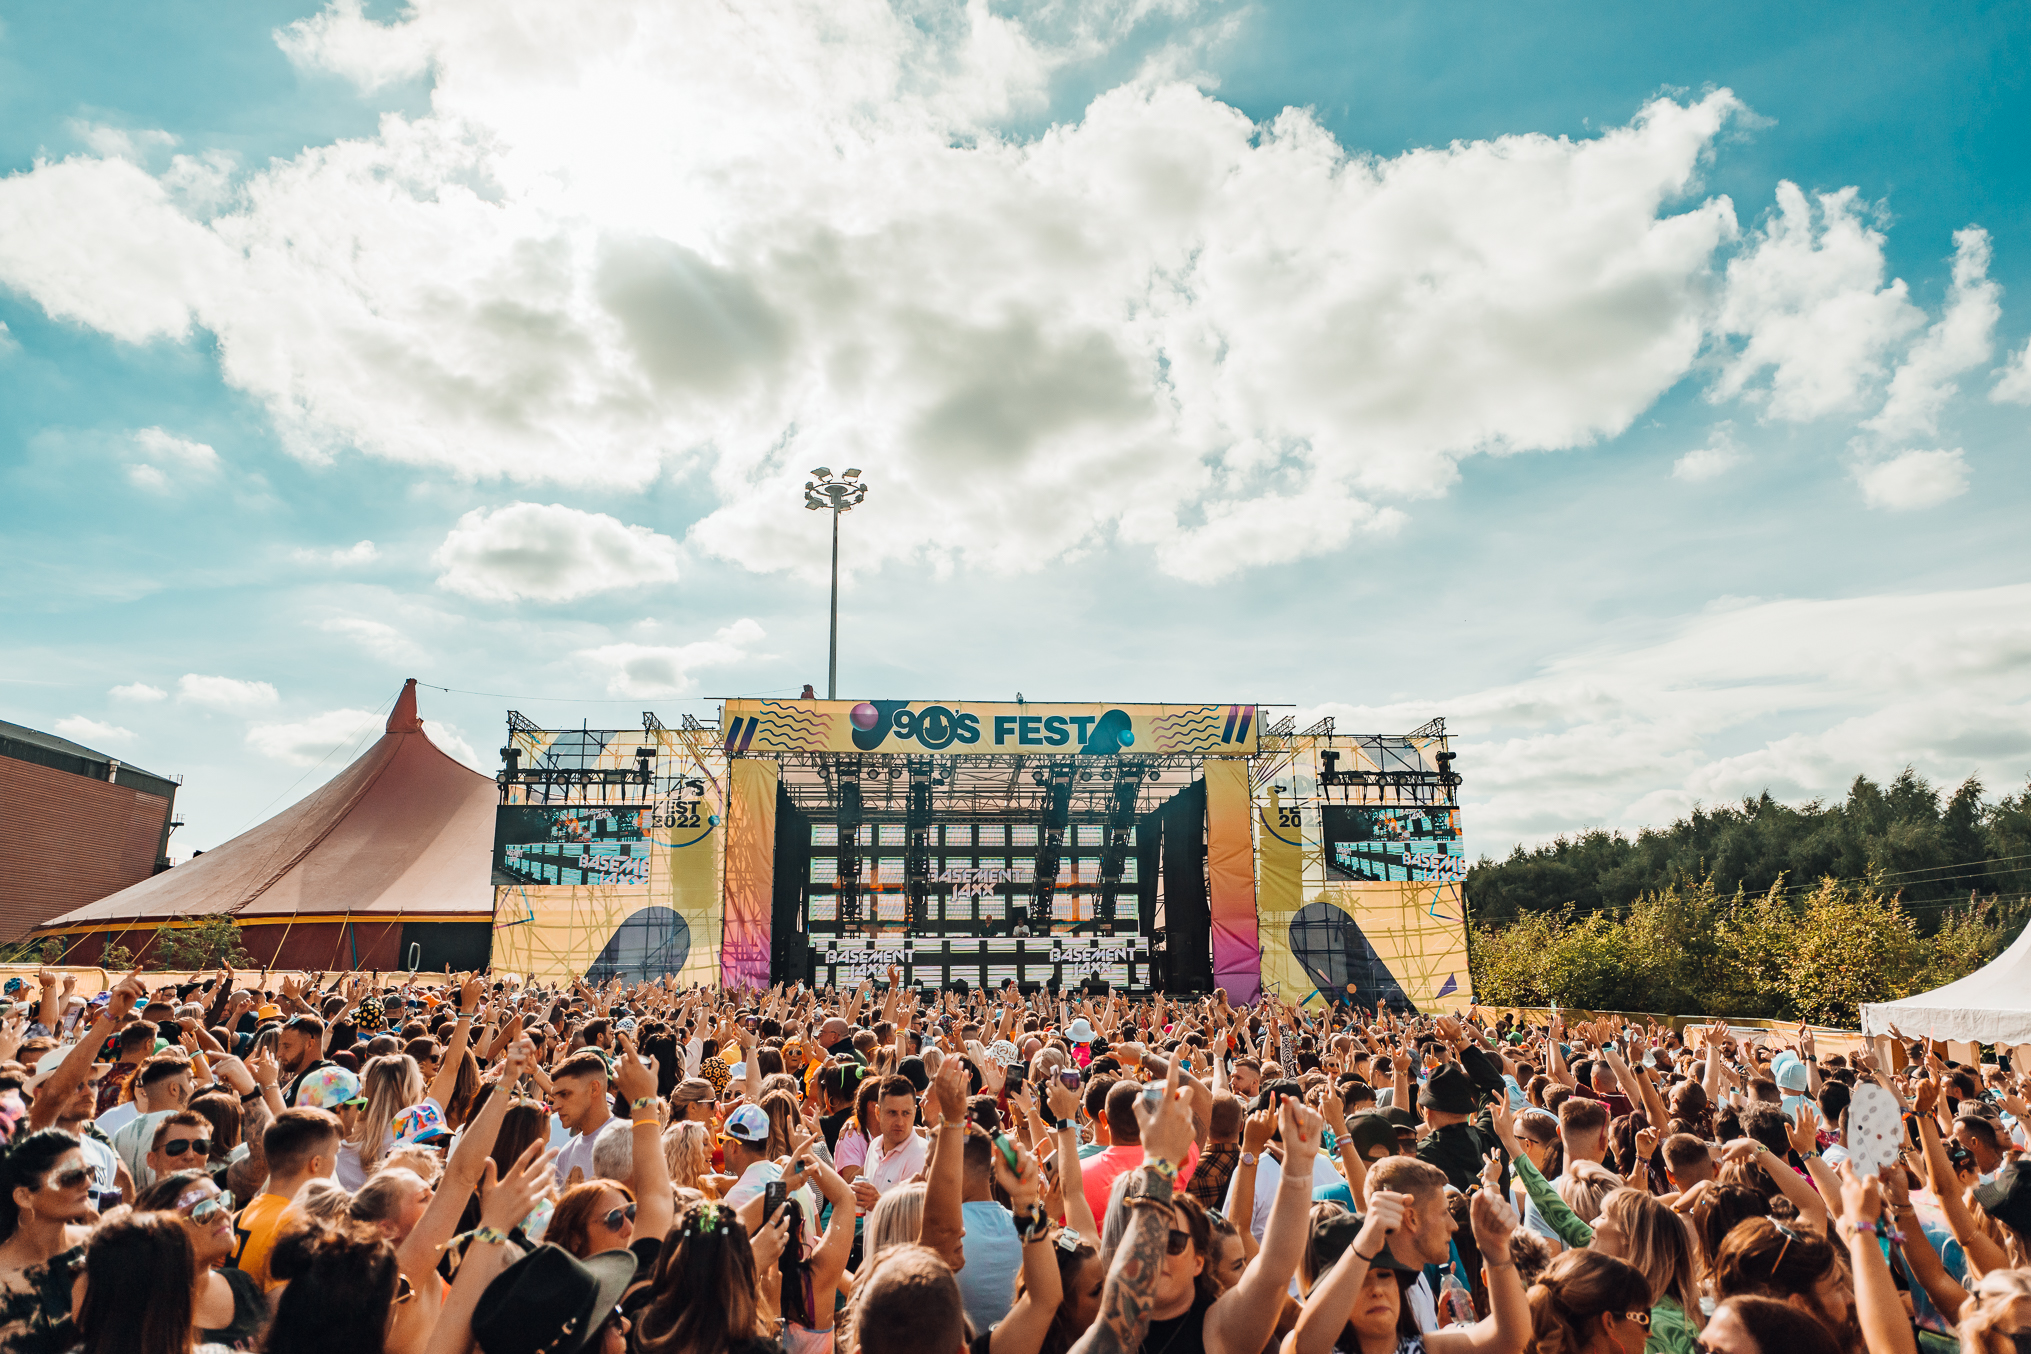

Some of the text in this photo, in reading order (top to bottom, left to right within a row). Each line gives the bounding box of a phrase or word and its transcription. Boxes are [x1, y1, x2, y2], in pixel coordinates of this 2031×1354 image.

[994, 715, 1096, 746] FEST
[951, 882, 996, 902] JAXX
[825, 949, 916, 964] BASEMENT
[1049, 947, 1137, 962] BASEMENT
[1073, 961, 1113, 977] JAXX
